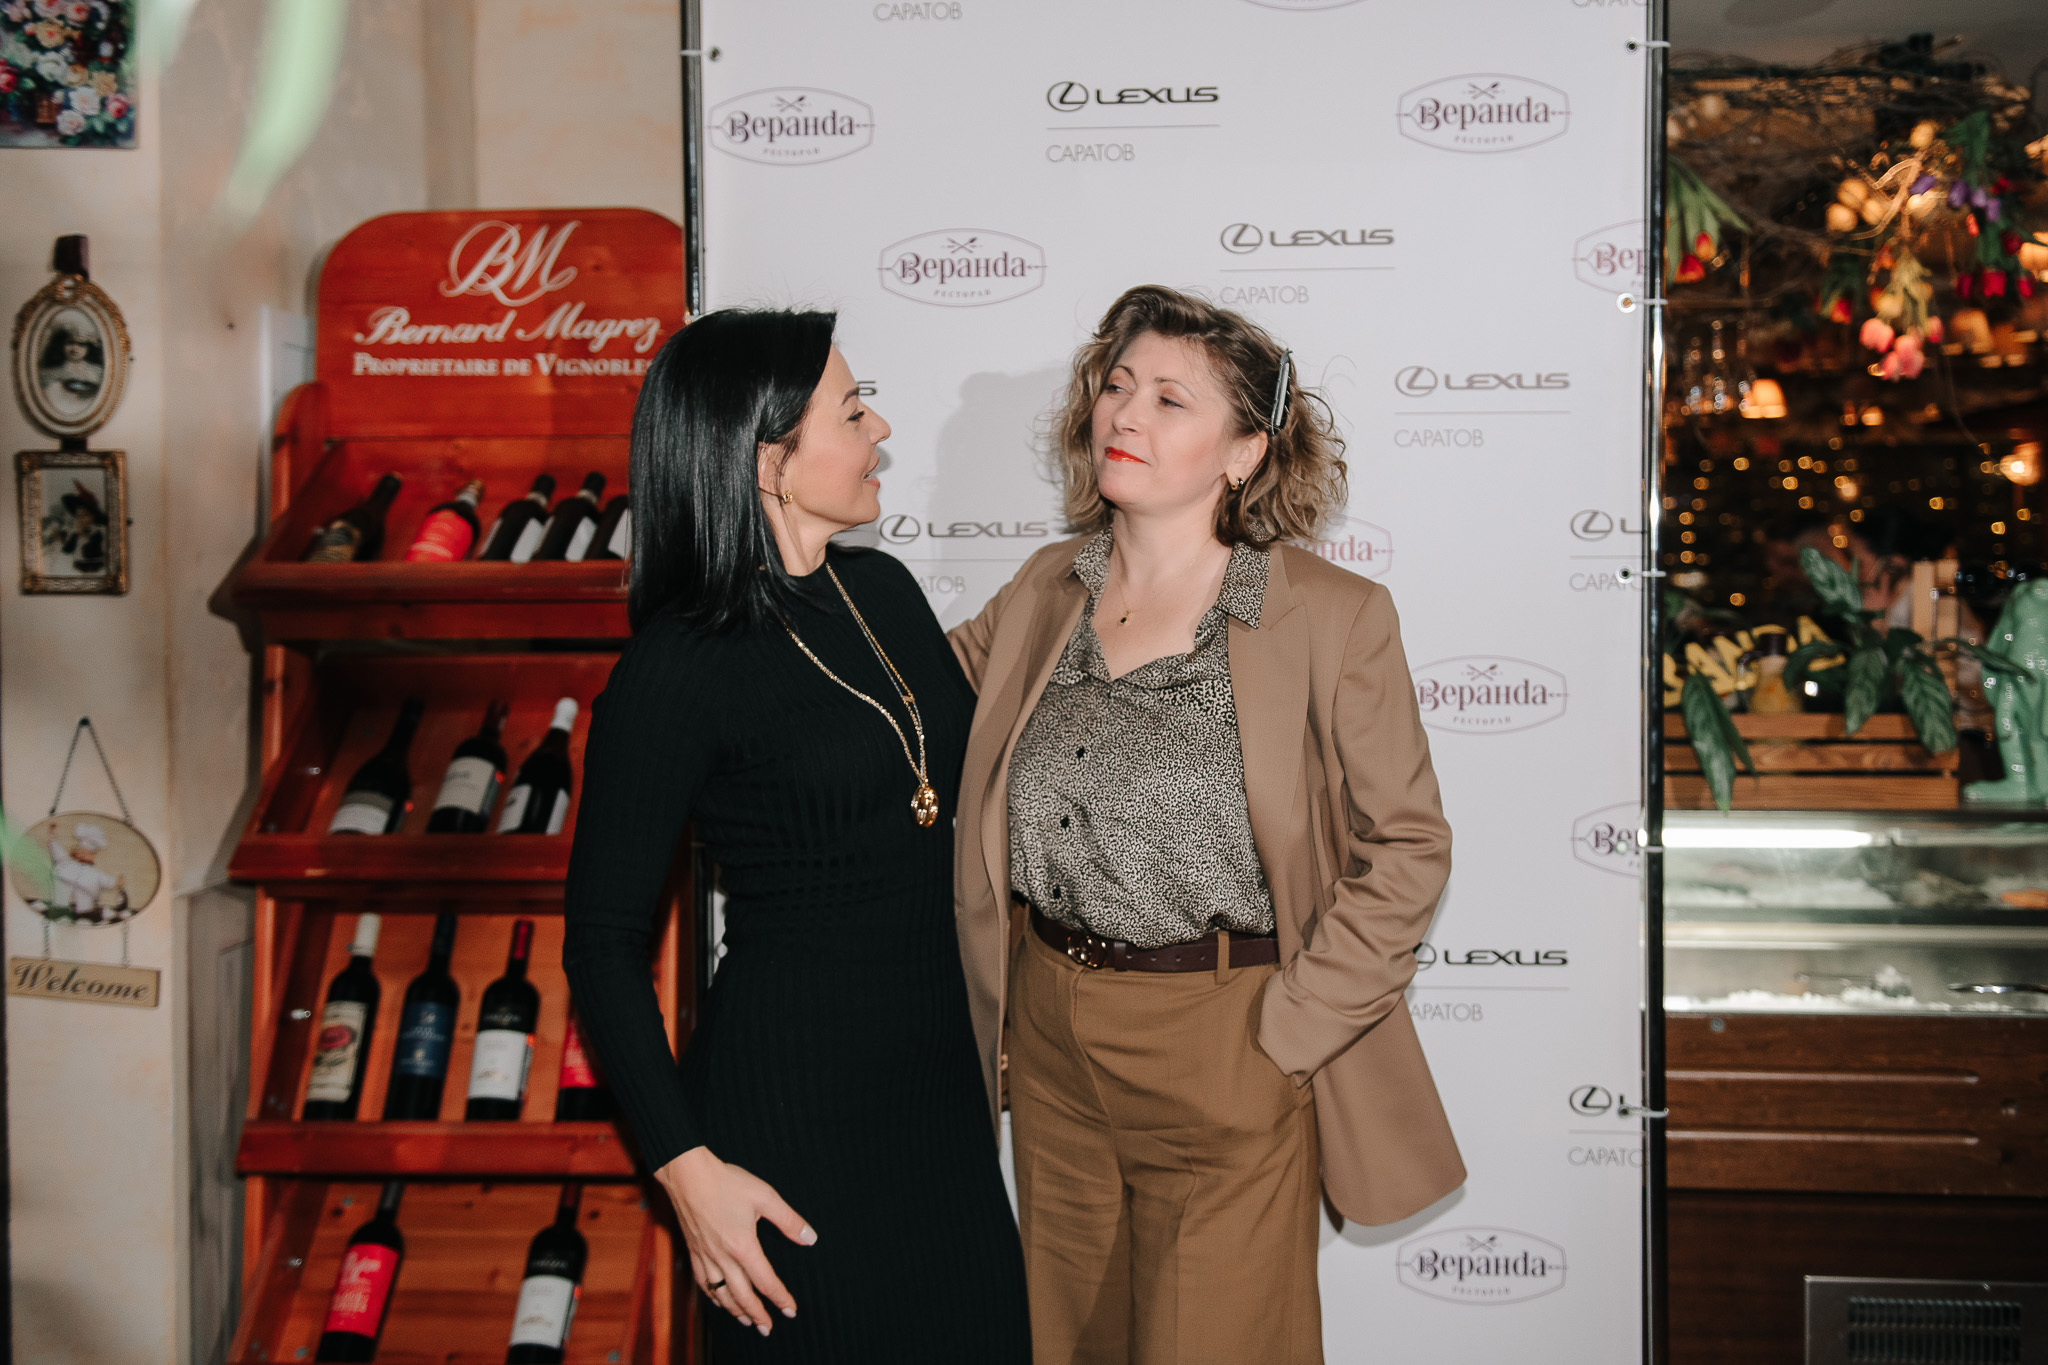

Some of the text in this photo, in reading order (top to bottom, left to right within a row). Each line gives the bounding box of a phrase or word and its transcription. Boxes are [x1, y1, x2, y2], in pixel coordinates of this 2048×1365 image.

[873, 2, 963, 22] САРАТОВ
[1096, 86, 1219, 104] LEXUS
[1046, 143, 1135, 163] САРАТОВ
[1270, 229, 1395, 247] LEXUS
[1220, 285, 1309, 304] САРАТОВ
[354, 301, 661, 353] Bernard Magrez
[1444, 372, 1570, 390] LEXUS
[1394, 429, 1484, 448] САРАТОВ
[928, 521, 1048, 538] LEXUS
[1444, 950, 1568, 966] LEXUS
[14, 963, 149, 1000] Welcome
[1410, 1003, 1483, 1022] АРАТОВ
[1567, 1146, 1642, 1168] САРАТО
